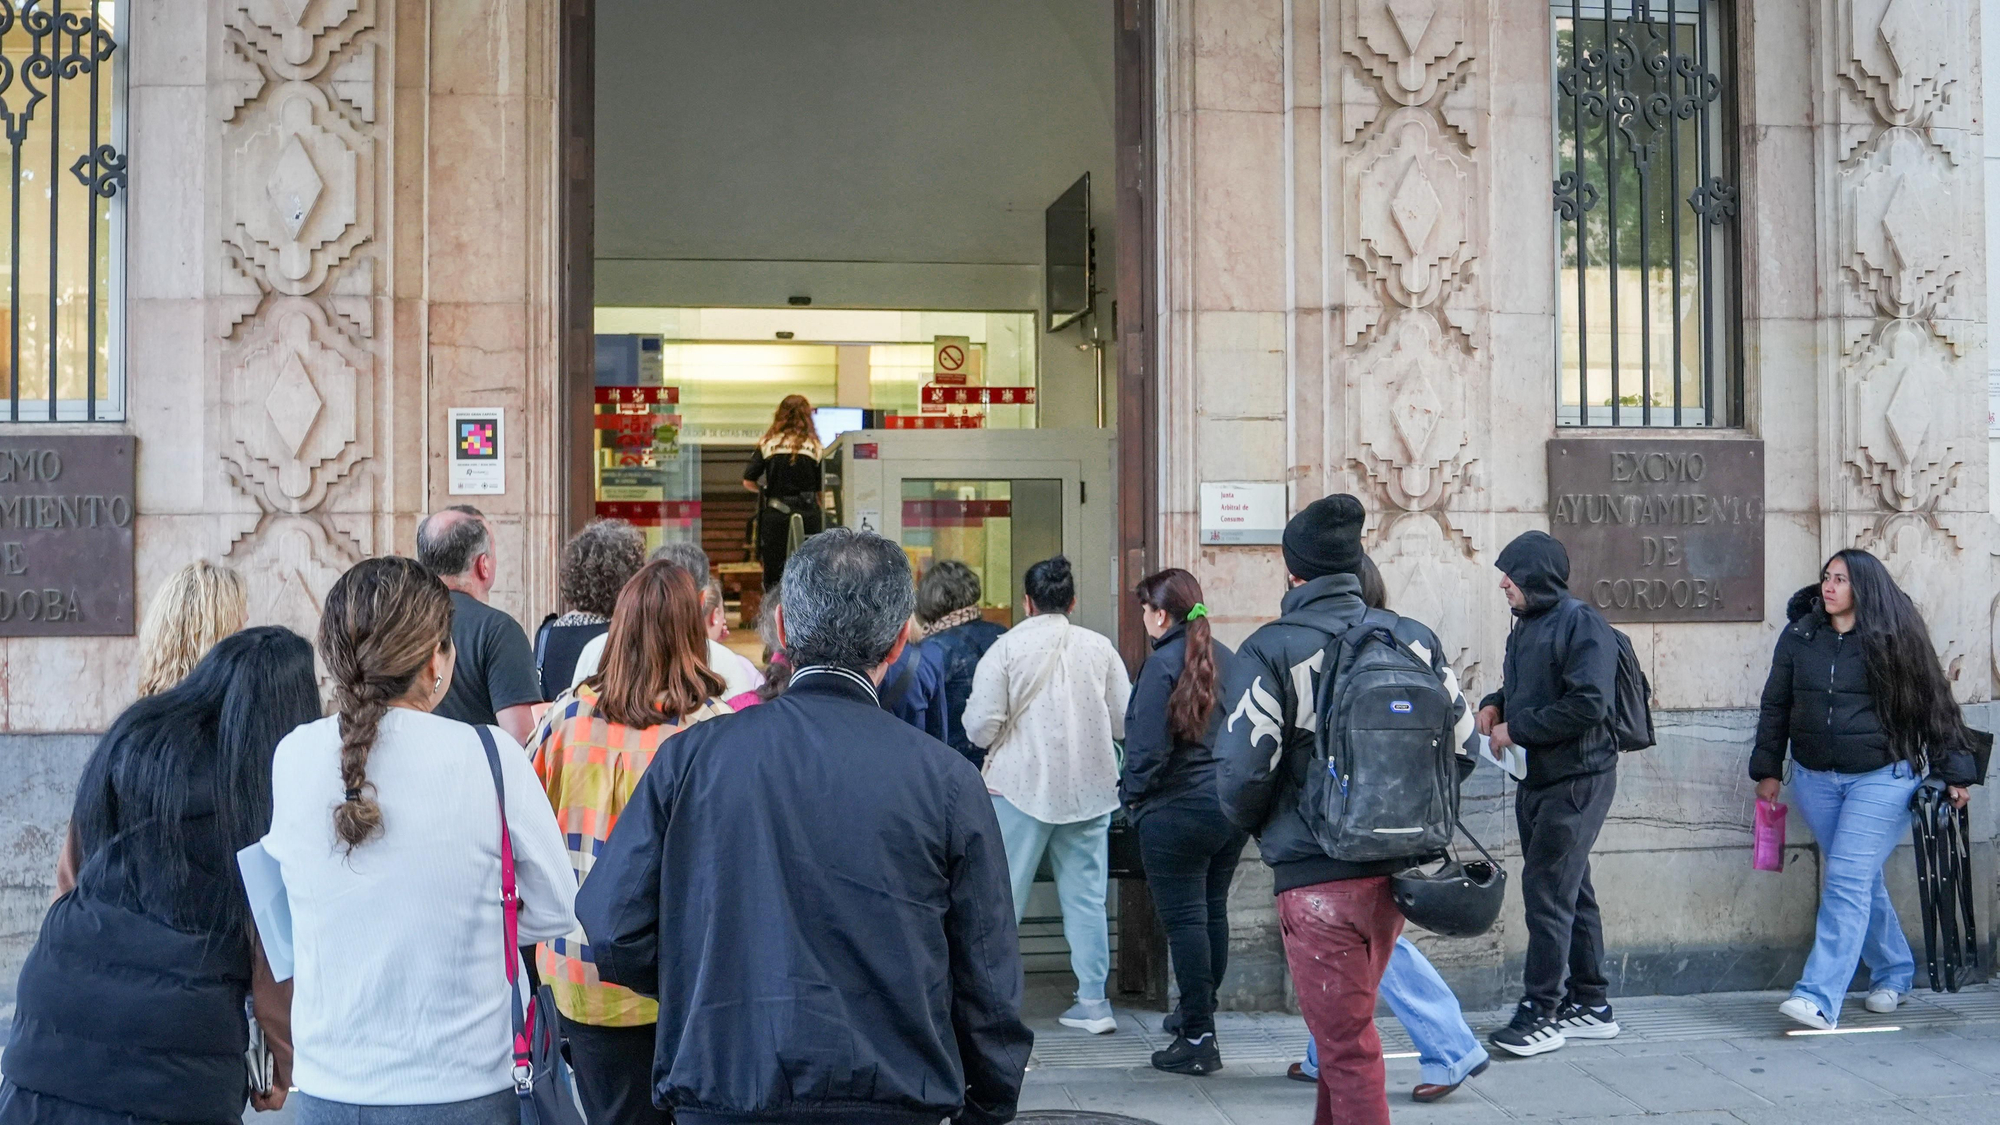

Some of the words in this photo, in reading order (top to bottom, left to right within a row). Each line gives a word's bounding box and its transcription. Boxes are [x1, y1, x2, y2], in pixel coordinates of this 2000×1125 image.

[1611, 452, 1706, 482] EXCMO
[1553, 494, 1764, 525] AYUNTAMIENTO
[3, 541, 28, 576] E
[1642, 536, 1681, 567] DE
[1592, 578, 1724, 610] CORDOBA
